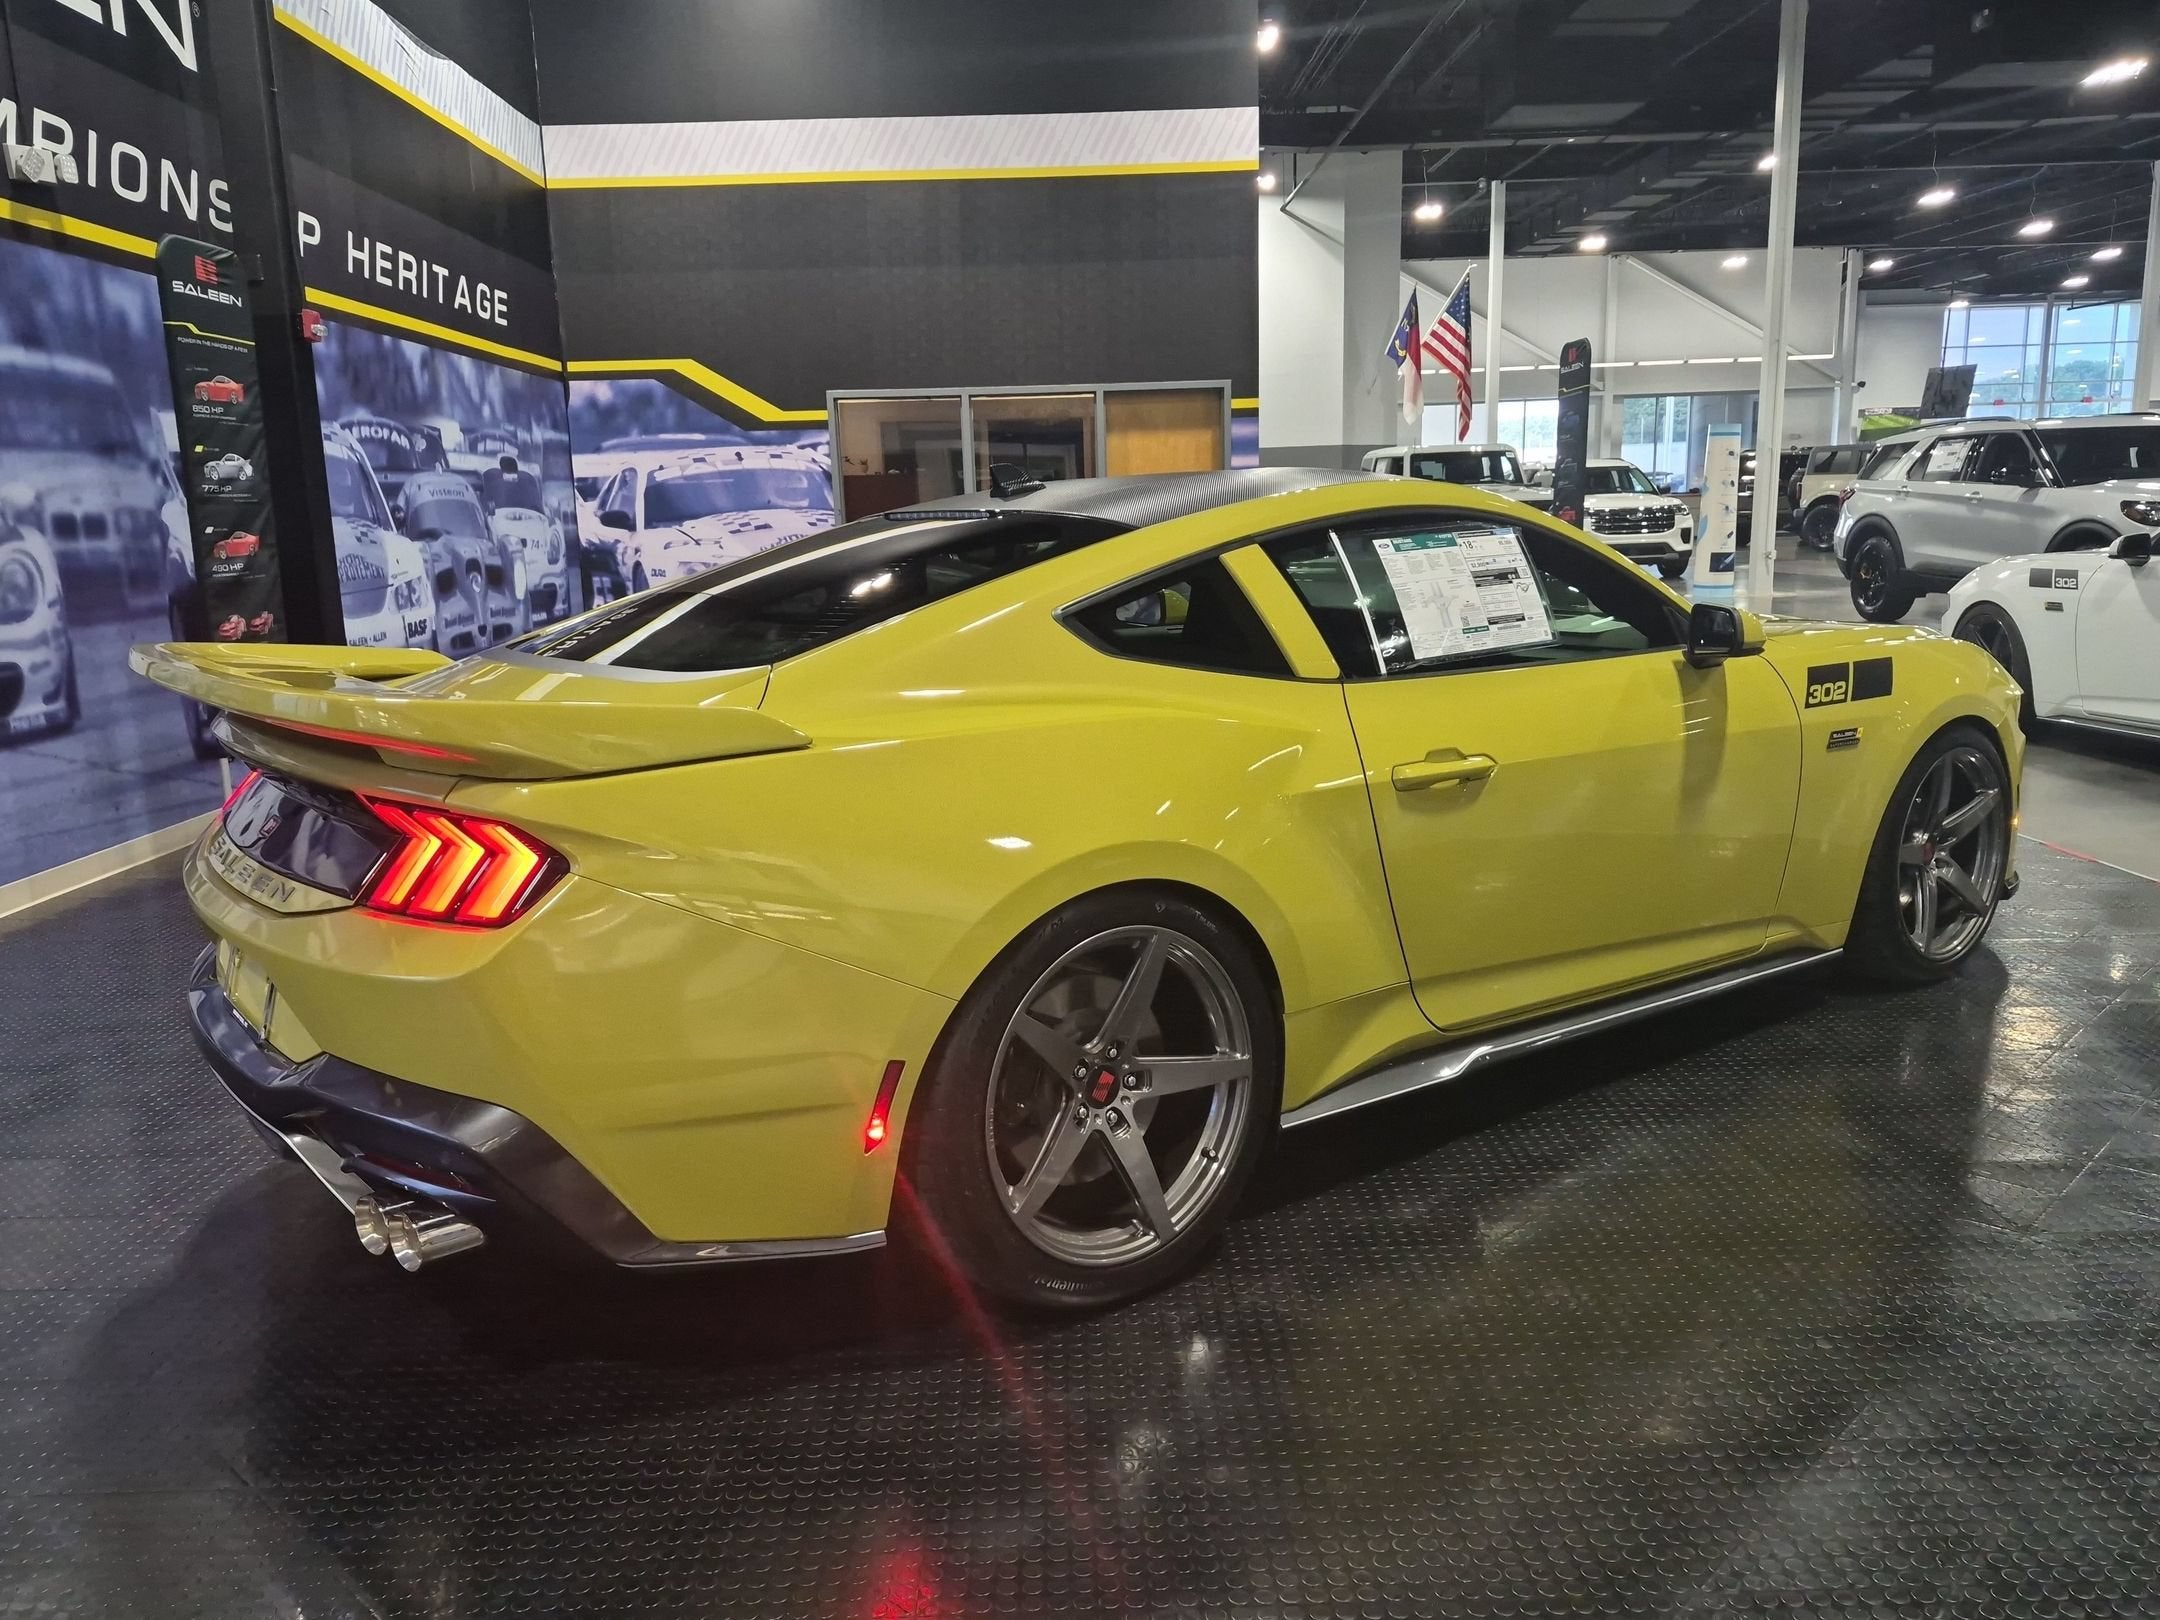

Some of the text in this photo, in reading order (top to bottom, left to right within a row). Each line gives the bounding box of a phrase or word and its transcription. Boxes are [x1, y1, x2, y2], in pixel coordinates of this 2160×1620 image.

[347, 230, 508, 326] HERITAGE
[172, 280, 242, 307] SALEEN
[202, 484, 219, 492] 775
[428, 487, 465, 498] Visteon
[229, 563, 244, 571] HP
[2055, 577, 2077, 588] 302
[407, 618, 428, 639] BASF
[373, 631, 387, 643] ALLEN
[1808, 681, 1847, 704] 302
[211, 836, 296, 903] SALEEN
